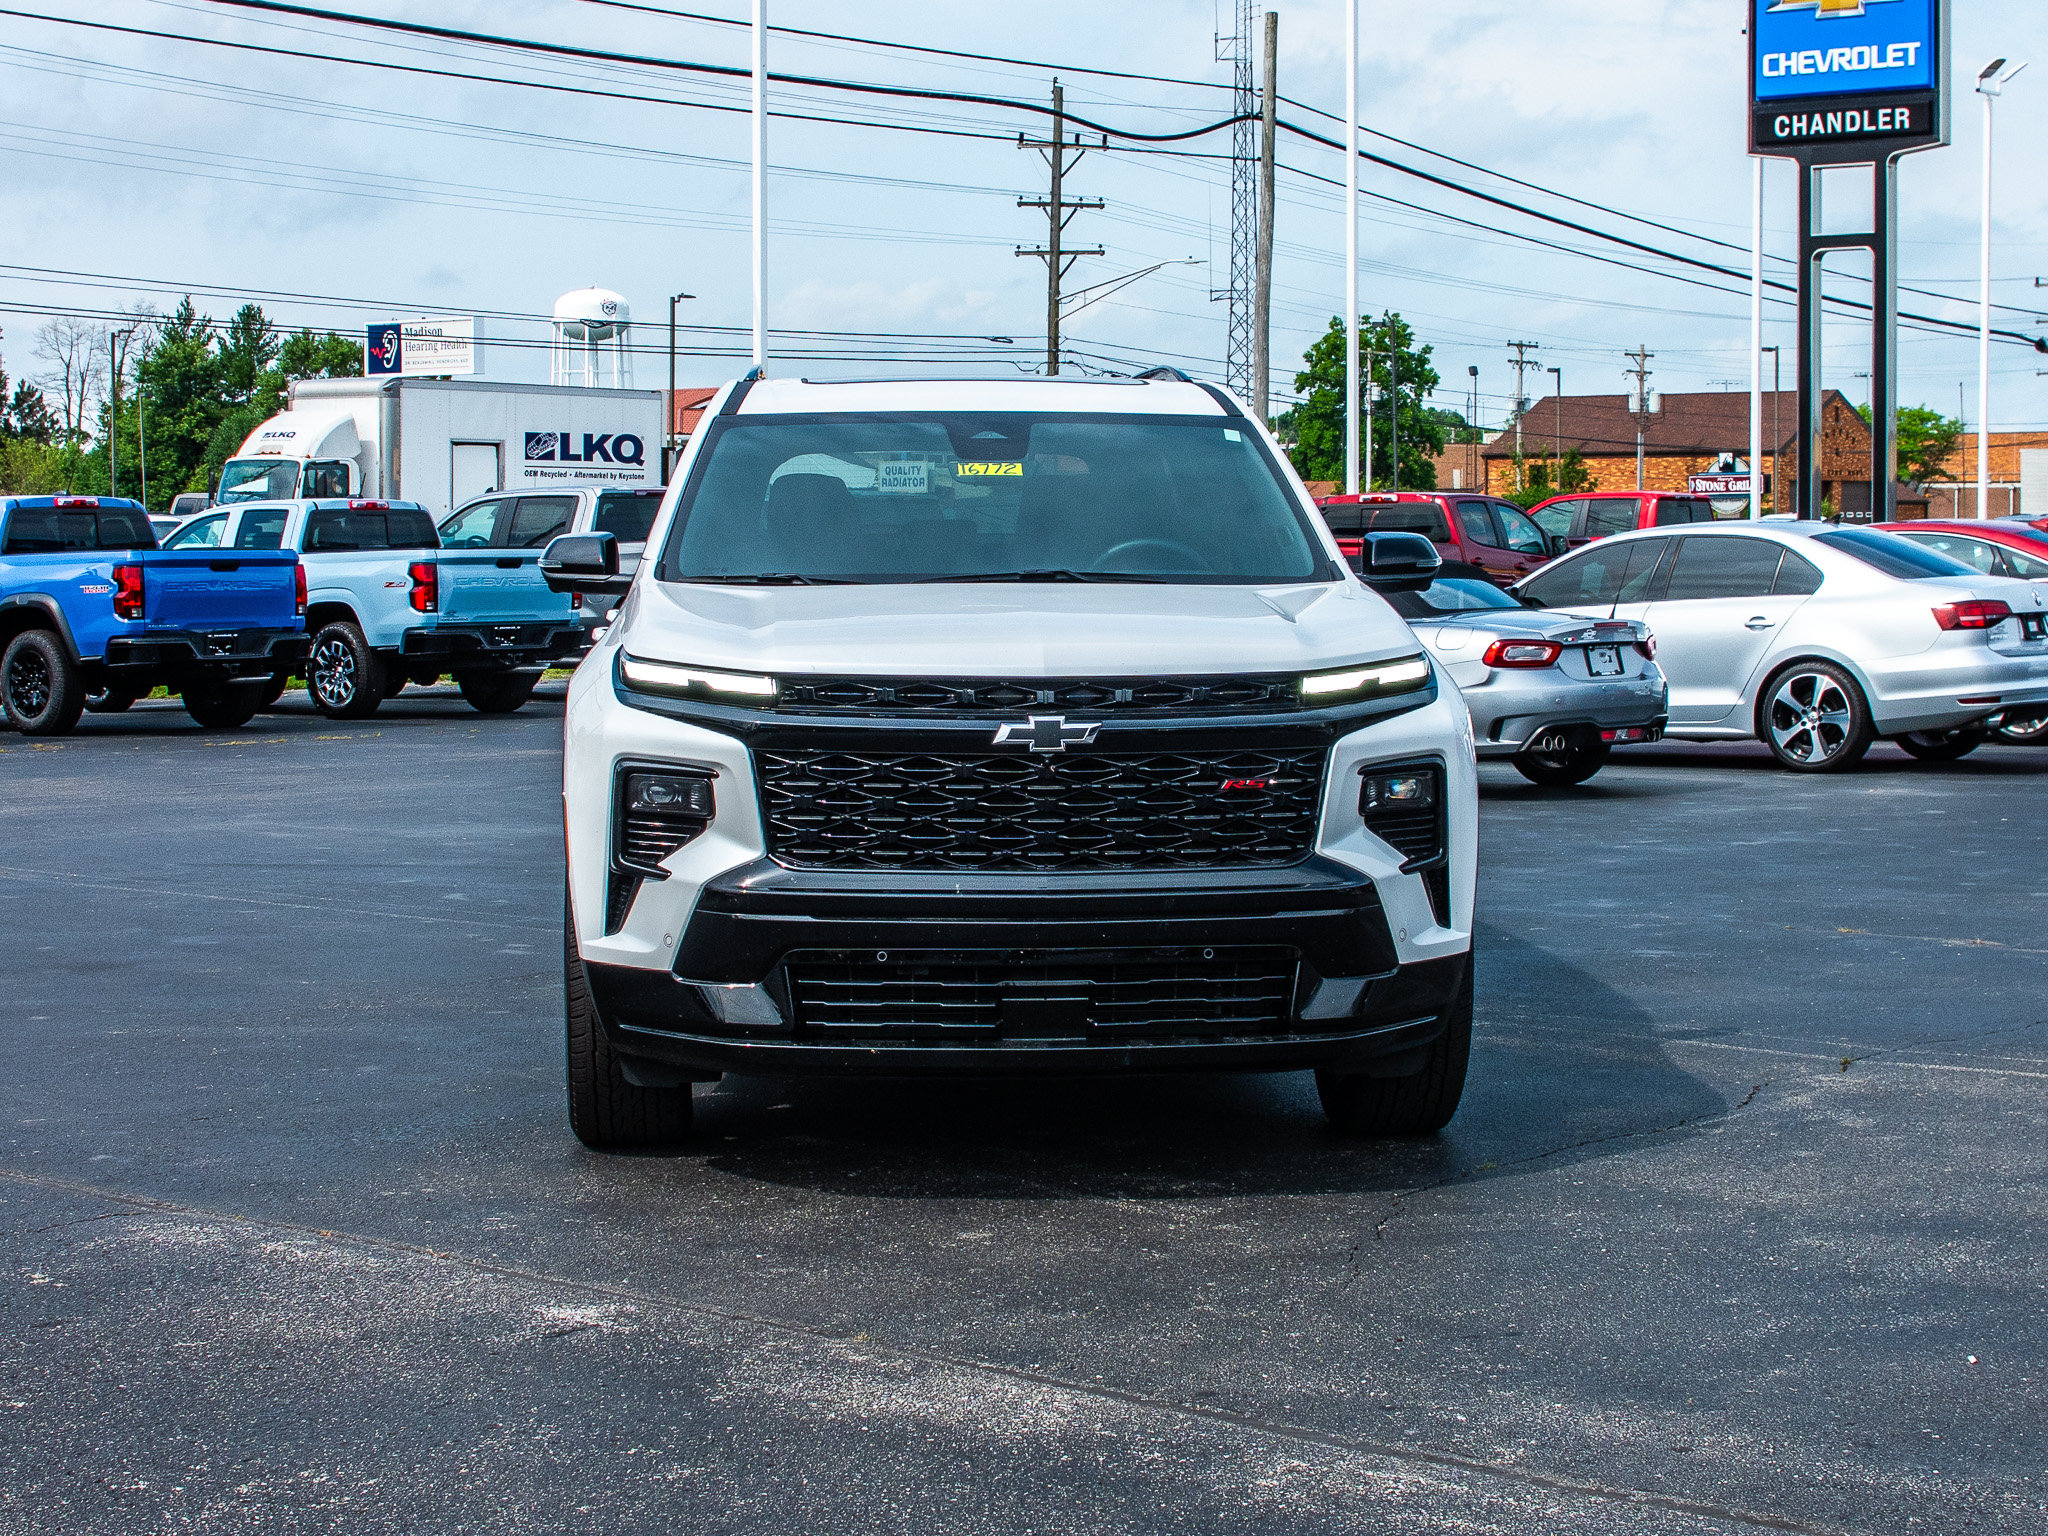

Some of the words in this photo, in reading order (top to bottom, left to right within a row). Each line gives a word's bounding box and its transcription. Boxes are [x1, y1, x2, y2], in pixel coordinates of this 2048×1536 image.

[1762, 42, 1921, 78] CHEVROLET
[1774, 107, 1911, 138] CHANDLER
[405, 326, 443, 338] Madison
[405, 341, 438, 353] Hearing
[440, 338, 468, 350] Health
[559, 432, 645, 466] LKQ
[540, 471, 567, 479] Recycled
[610, 472, 617, 480] by
[885, 466, 921, 475] QUALITY
[881, 477, 925, 487] RADIATOR
[1695, 479, 1726, 491] STONE
[1728, 480, 1750, 491] GRIL
[454, 577, 548, 587] CHEVROL
[1221, 779, 1266, 789] RS
